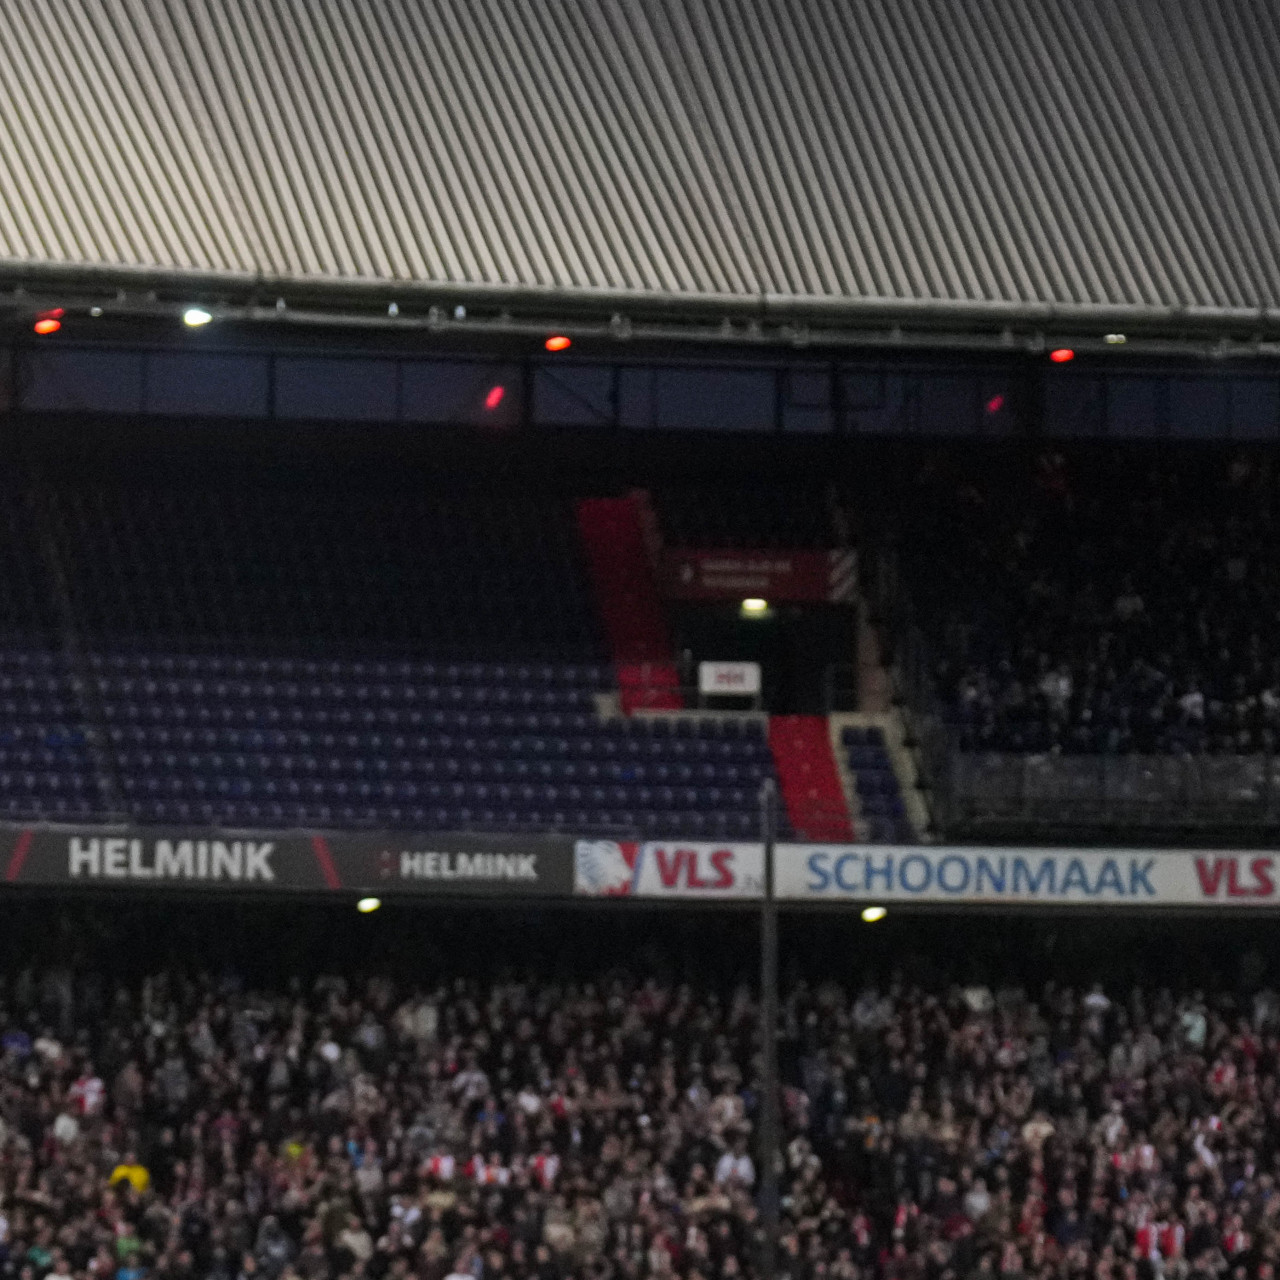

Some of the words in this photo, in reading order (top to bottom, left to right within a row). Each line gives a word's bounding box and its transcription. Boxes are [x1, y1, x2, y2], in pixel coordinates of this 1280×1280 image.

[68, 838, 275, 880] HELMINK
[400, 851, 538, 881] HELMINK
[807, 853, 1156, 896] SCHOONMAAK
